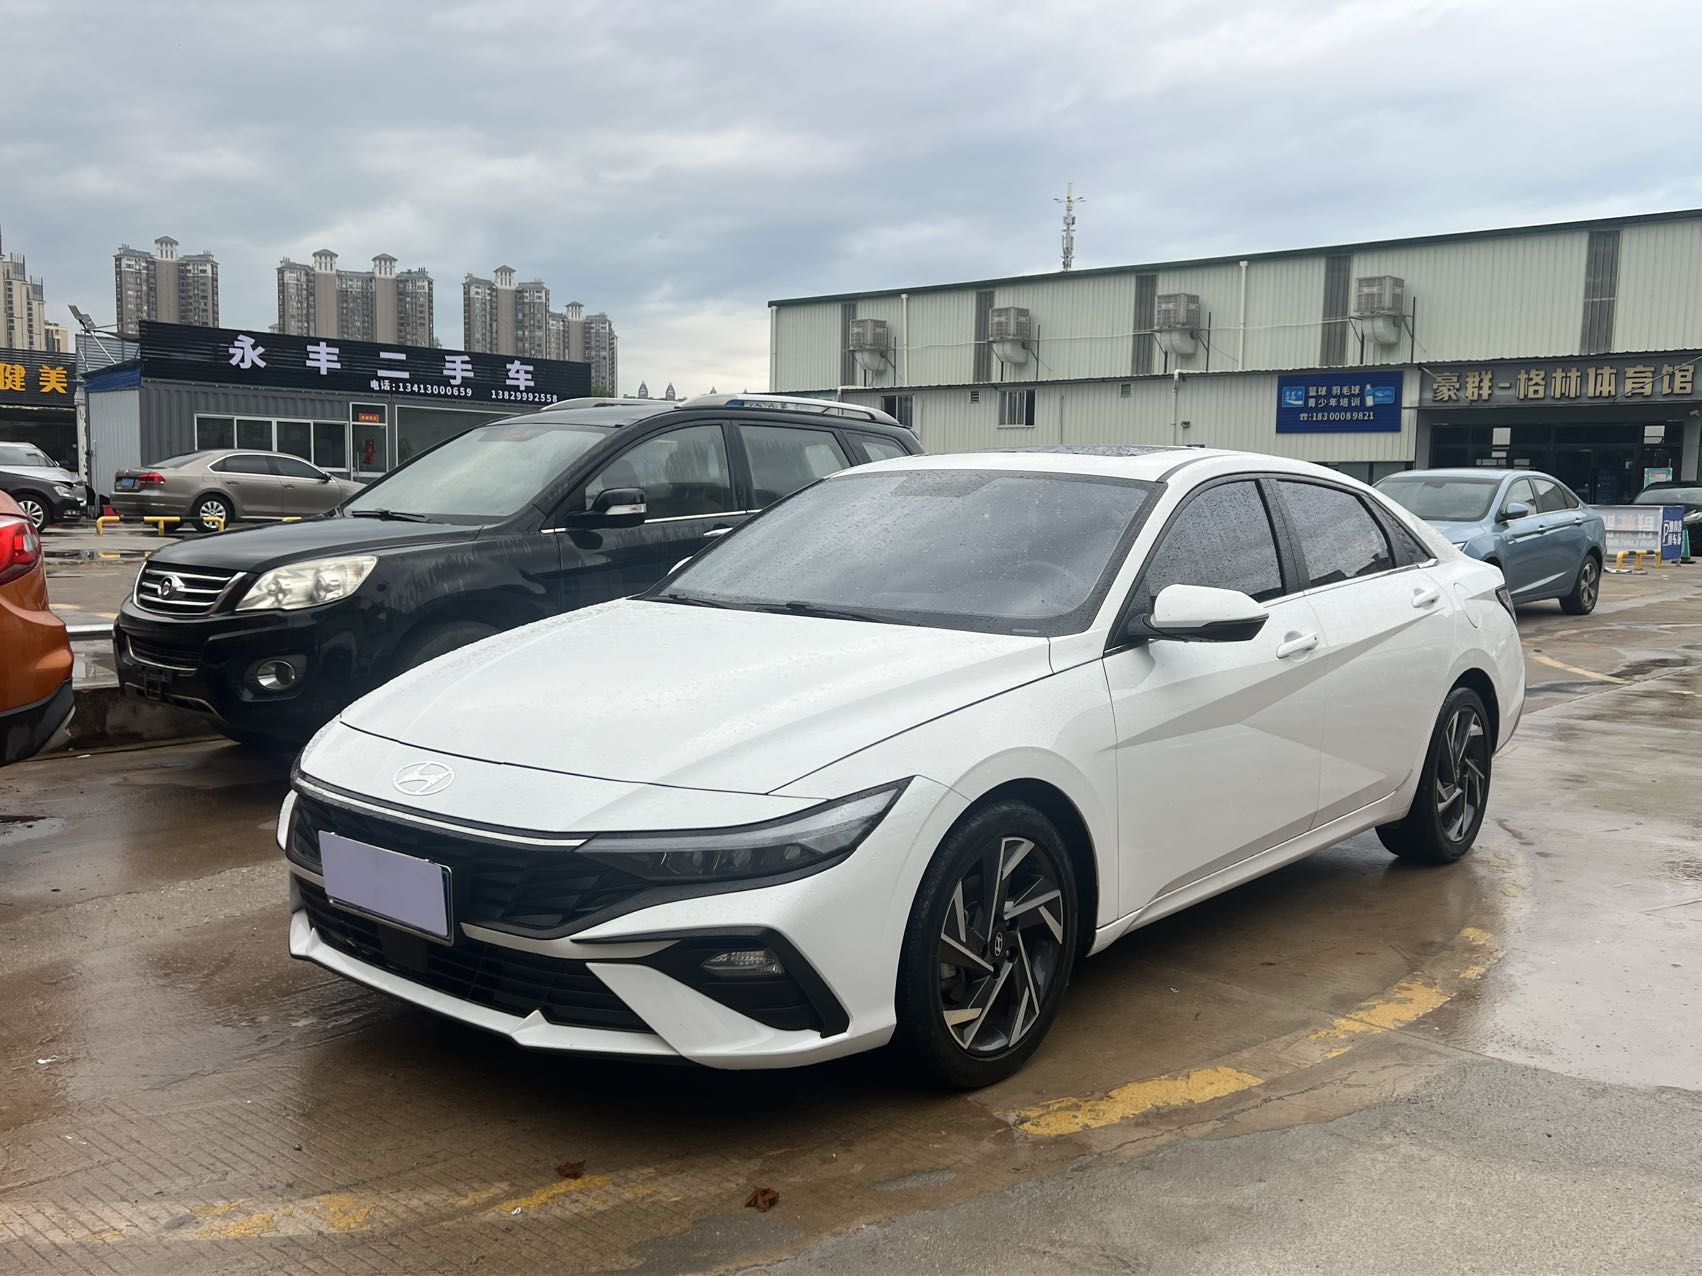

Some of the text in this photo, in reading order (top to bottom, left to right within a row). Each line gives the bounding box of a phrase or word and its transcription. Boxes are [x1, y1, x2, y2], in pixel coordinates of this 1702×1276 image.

[228, 334, 535, 390] 永丰二手车
[0, 363, 68, 394] 健美
[491, 390, 558, 403] 13829992558
[1309, 386, 1327, 396] 篮球
[1332, 385, 1361, 395] 羽毛球
[1308, 397, 1361, 408] 青少年培训
